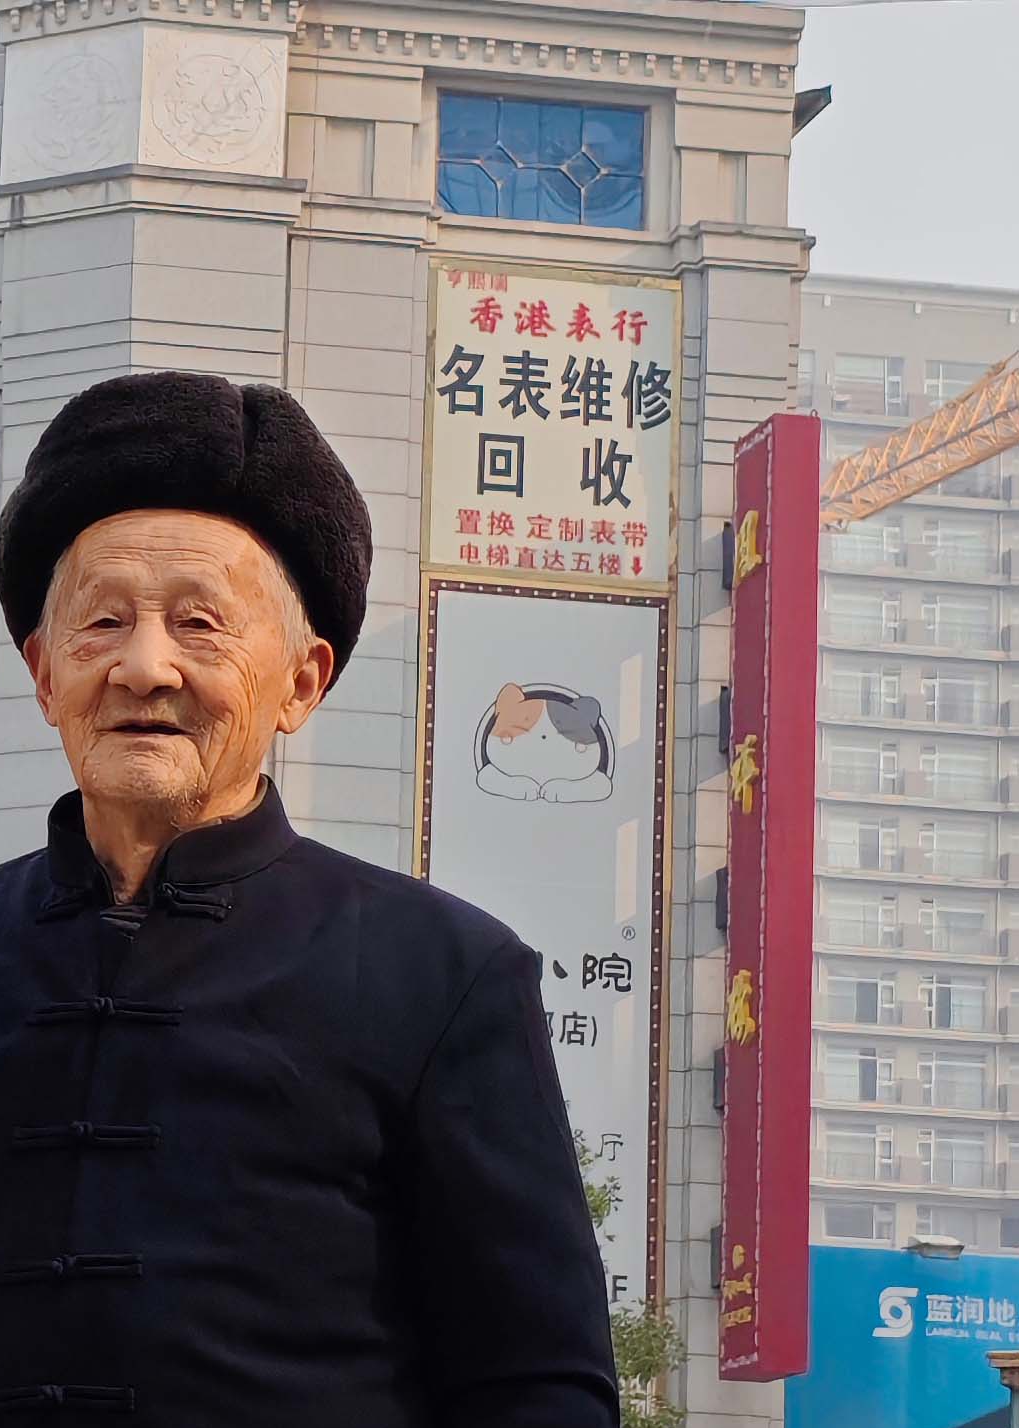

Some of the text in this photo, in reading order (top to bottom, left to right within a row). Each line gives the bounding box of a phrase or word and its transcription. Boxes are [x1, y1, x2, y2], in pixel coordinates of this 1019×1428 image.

[470, 297, 649, 346] 香港表行
[436, 344, 672, 430] 名表维修
[477, 432, 633, 509] 回收
[526, 513, 648, 548] 定制表带
[459, 541, 622, 576] 电梯直达五楼
